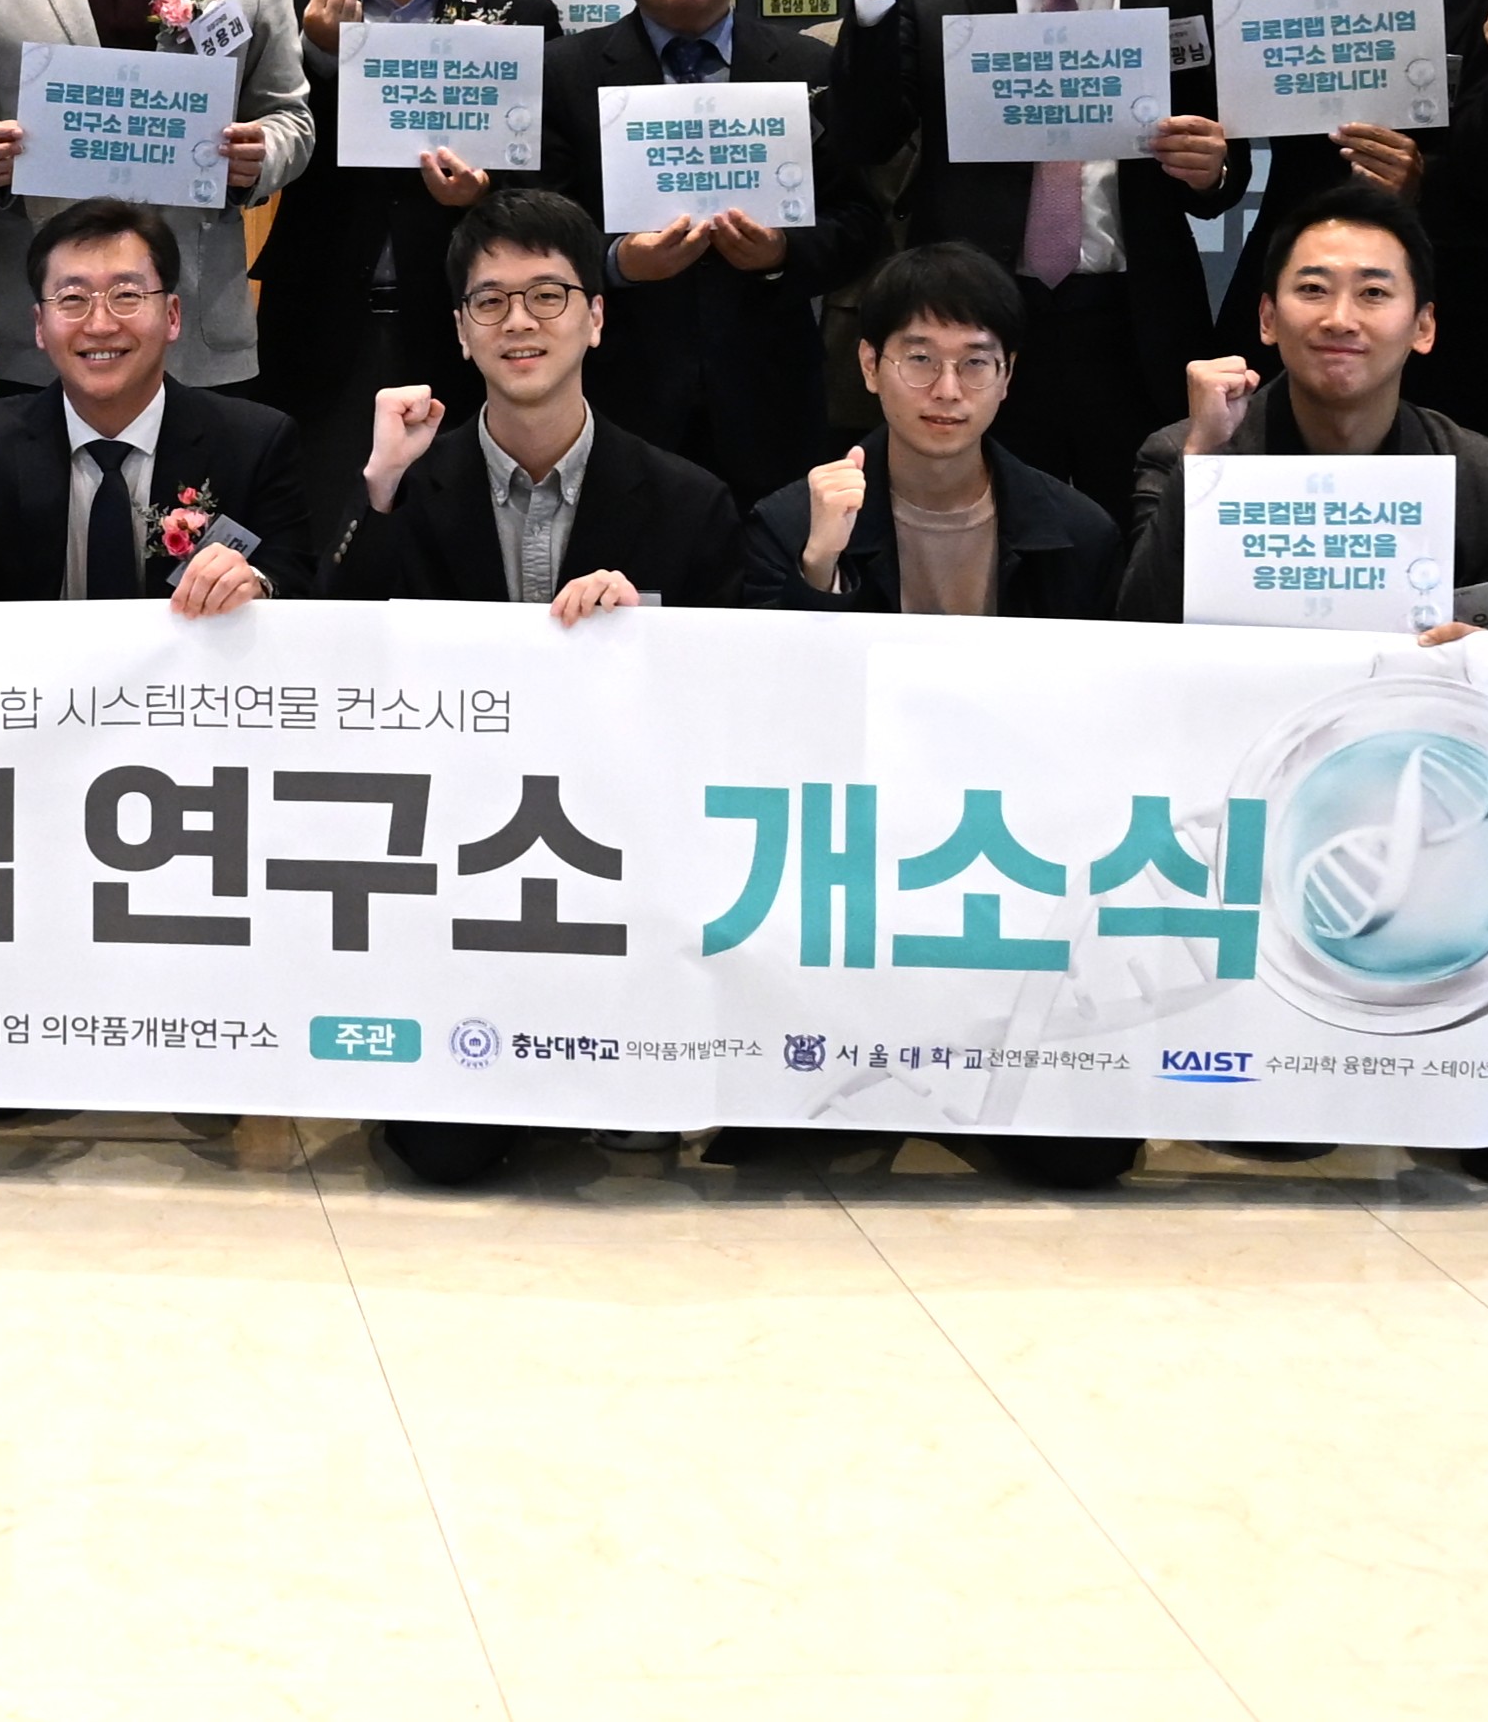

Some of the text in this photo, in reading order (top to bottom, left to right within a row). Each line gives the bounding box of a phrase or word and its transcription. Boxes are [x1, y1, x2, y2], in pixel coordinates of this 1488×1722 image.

[1240, 9, 1417, 43] 글로컬랩 컨소시엄
[970, 47, 1143, 74] 글로컬랩 컨소시엄
[1262, 39, 1397, 69] 연구소 발전을
[362, 58, 519, 82] 글로컬랩 컨소시엄
[1273, 69, 1387, 96] 응원합니다!
[45, 82, 209, 114] 글로컬랩 컨소시엄
[381, 84, 500, 107] 연구소 발전을
[991, 75, 1123, 100] 연구소 발전을
[62, 110, 187, 140] 연구소 발전을
[389, 109, 490, 132] 응원합니다!
[1002, 103, 1114, 127] 응원합니다!
[625, 117, 786, 142] 글로컬랩 컨소시엄
[68, 137, 176, 165] 응원합니다!
[646, 142, 768, 167] 연구소 발전을
[656, 169, 761, 193] 응원합니다!
[1217, 500, 1423, 526] 글로컬랩 컨소시엄
[1242, 533, 1398, 559] 연구소 발전을
[1253, 565, 1387, 591] 응원합니다!
[58, 684, 318, 729] 시스템천연물
[337, 688, 509, 733] 컨소시엄
[85, 765, 627, 956] 연구소
[700, 781, 1268, 982] 개소식
[42, 1015, 278, 1049] 의약품개발연구소
[333, 1022, 397, 1057] 주관
[512, 1033, 619, 1061] 충남대학교
[626, 1039, 762, 1061] 의약품개발연구소
[837, 1044, 982, 1069] 서울대학교
[988, 1048, 1131, 1072] 천연물과학연구소
[1162, 1050, 1253, 1072] KAIST
[1266, 1056, 1337, 1074] 수리과학
[1344, 1056, 1414, 1076] 융합연구
